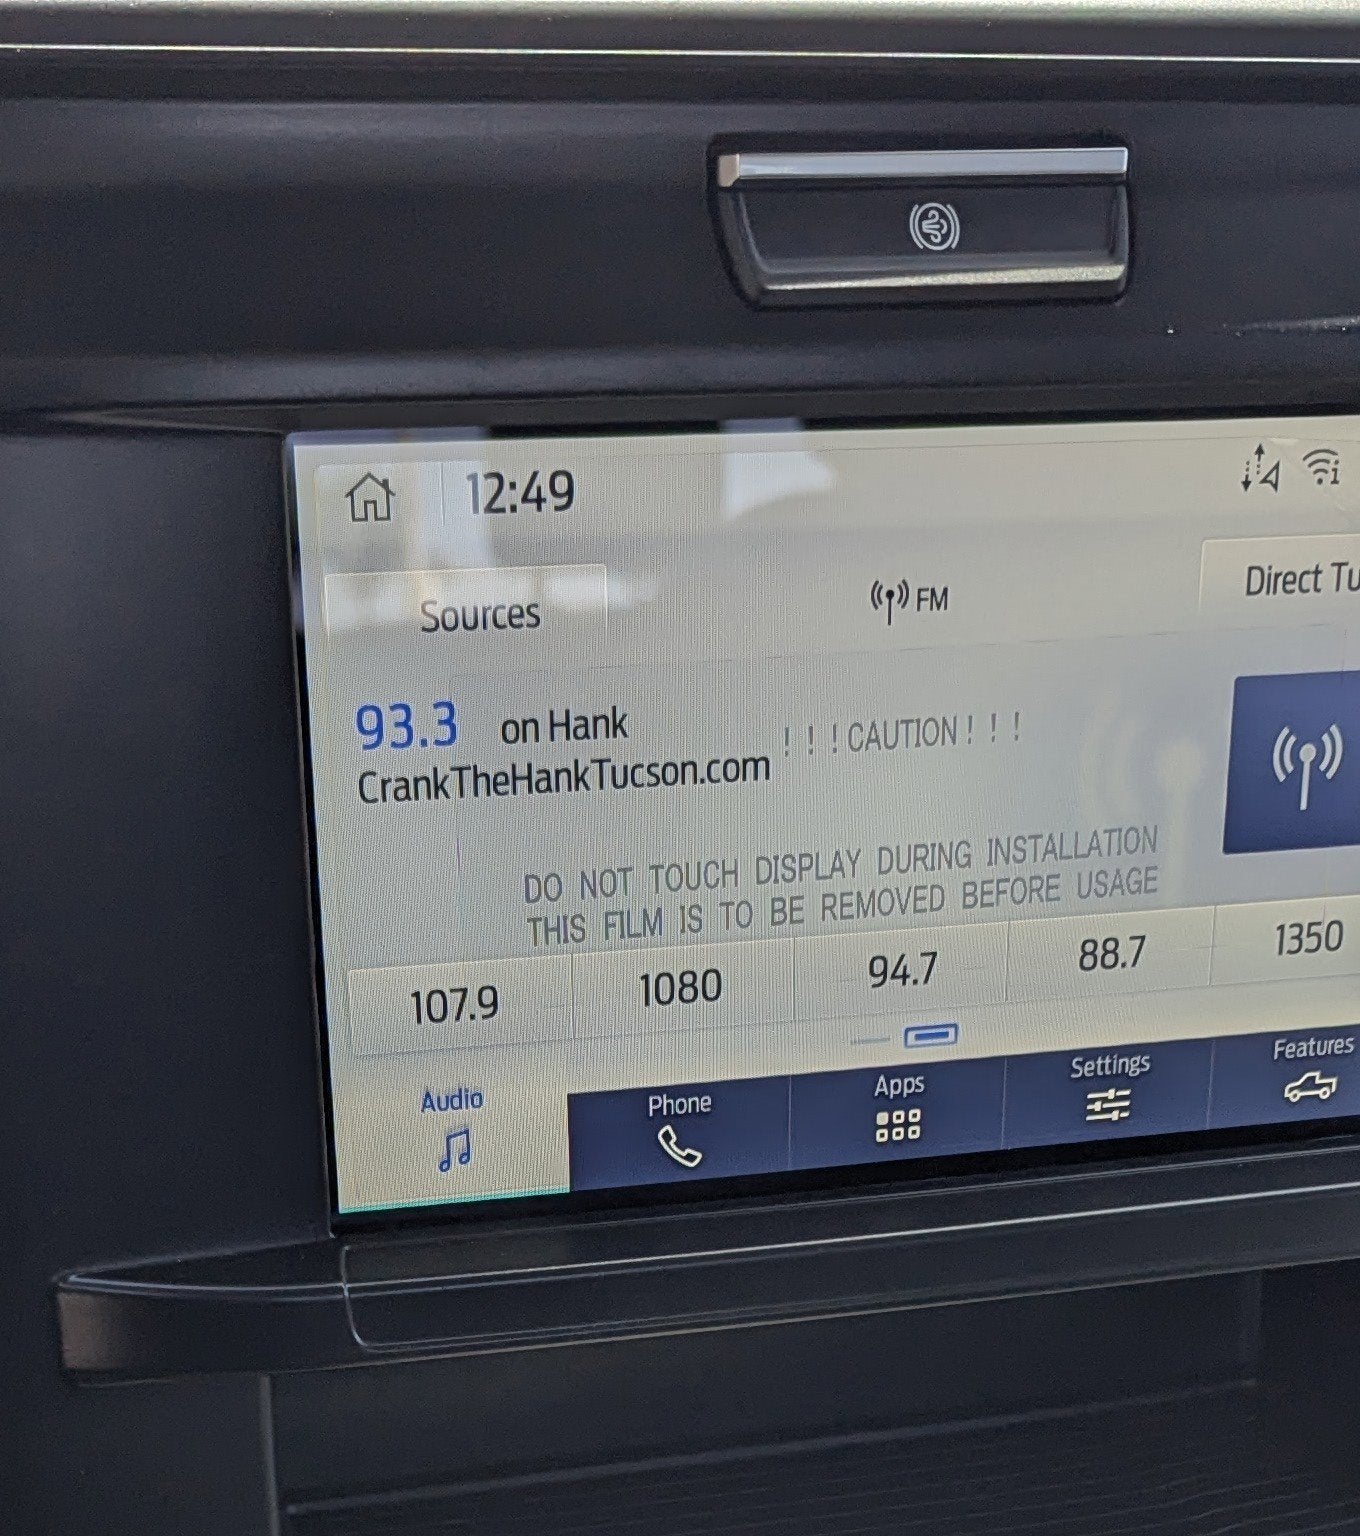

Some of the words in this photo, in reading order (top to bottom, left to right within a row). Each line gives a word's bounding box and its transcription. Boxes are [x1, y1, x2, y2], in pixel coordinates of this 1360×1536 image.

[465, 468, 577, 514] 12:49
[1245, 562, 1324, 597] Direct
[419, 600, 541, 633] Sources
[916, 586, 950, 612] FM
[354, 700, 459, 751] 93.3
[500, 717, 540, 745] on
[548, 705, 629, 742] Hank
[358, 755, 771, 804] CrankTheHankTucson.com
[524, 872, 564, 904] DO
[580, 866, 634, 900] NOT
[648, 858, 739, 894] TOUCH
[755, 847, 862, 886] DISPLAY
[877, 839, 972, 876] DURING
[986, 824, 1159, 867] INSTALLATION
[526, 913, 587, 947] THIS
[604, 906, 664, 941] FILM
[679, 903, 704, 934] IS
[718, 899, 754, 931] TO
[770, 894, 805, 927] BE
[821, 883, 946, 922] REMOVED
[961, 873, 1062, 910] BEFORE
[1077, 865, 1159, 900] USAGE
[1077, 934, 1148, 972] 88.7
[1275, 920, 1345, 956] 1350
[639, 968, 724, 1007] 1080
[867, 951, 939, 989] 94.7
[410, 985, 500, 1025] 107.9
[1070, 1052, 1151, 1080] Settings
[1273, 1034, 1356, 1061] Features
[420, 1087, 484, 1114] Audio
[873, 1073, 926, 1099] Apps
[647, 1092, 713, 1118] Phone
